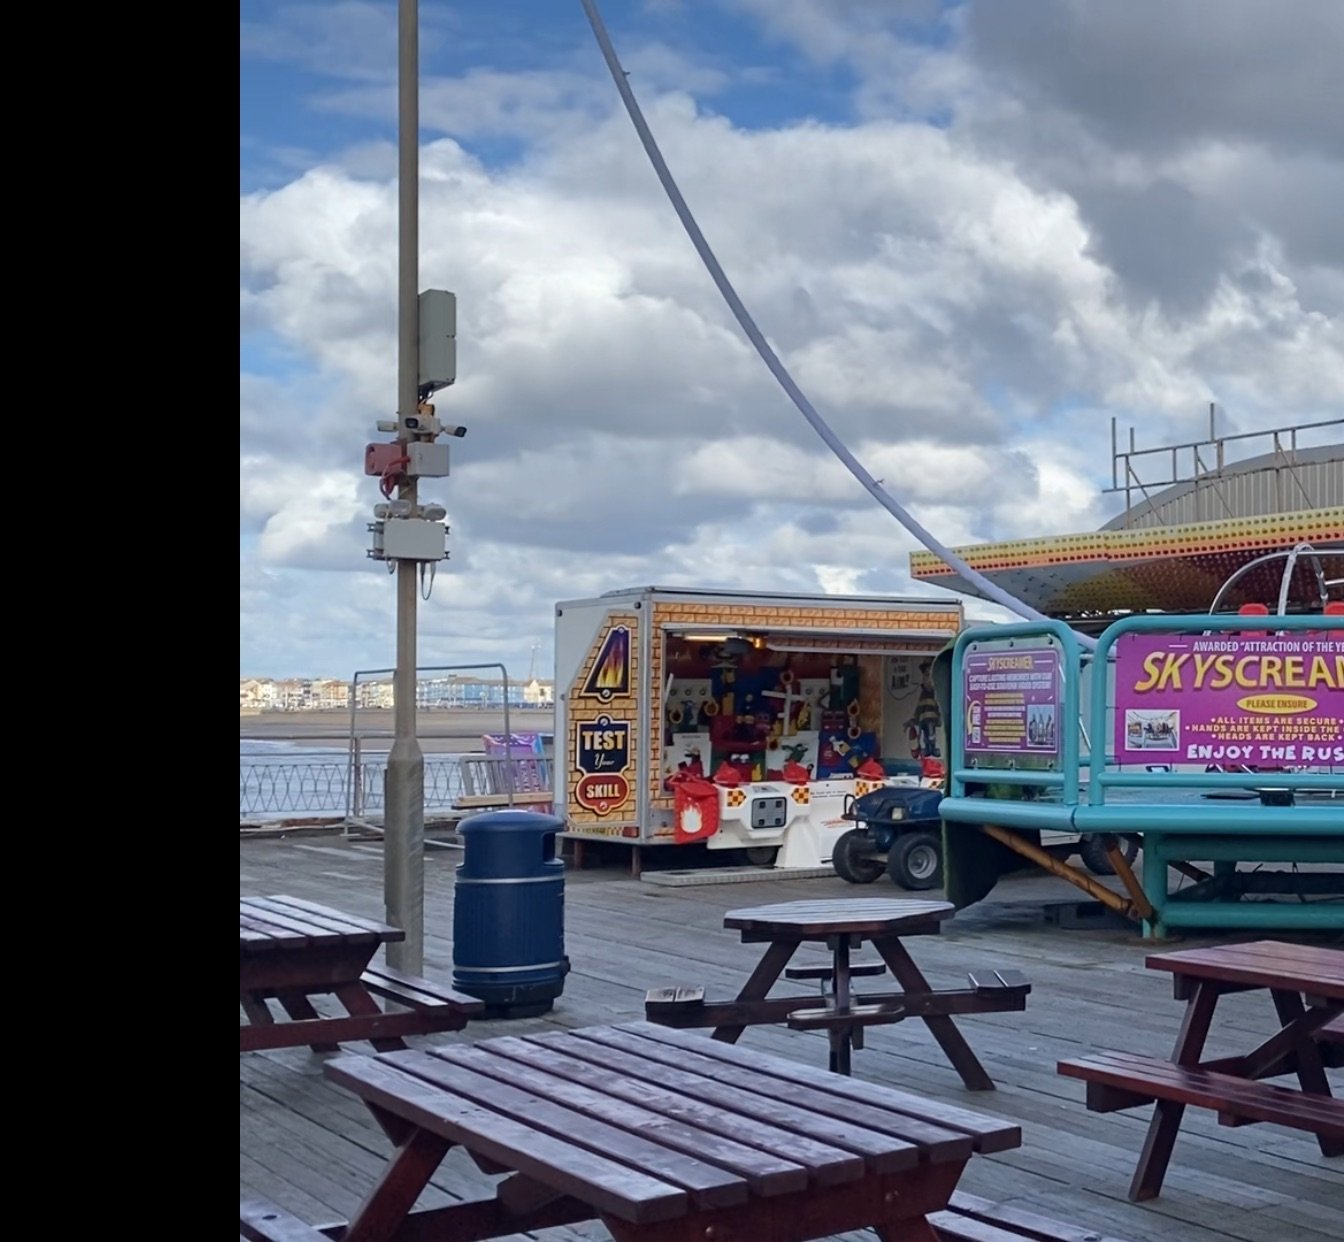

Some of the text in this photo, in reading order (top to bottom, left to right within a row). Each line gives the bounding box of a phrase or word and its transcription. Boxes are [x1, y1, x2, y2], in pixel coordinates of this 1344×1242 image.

[1193, 641, 1239, 652] AWARDED
[1240, 642, 1300, 652] "ATTRACTION
[1302, 642, 1314, 653] OF
[1316, 642, 1334, 653] THE
[1246, 700, 1308, 709] PLEASE ENSURE
[1240, 716, 1270, 724] ITEMS
[582, 730, 626, 750] TEST
[1187, 744, 1254, 759] ENJOY
[1260, 745, 1296, 760] THE
[594, 752, 615, 770] Your
[586, 784, 620, 798] SKILL
